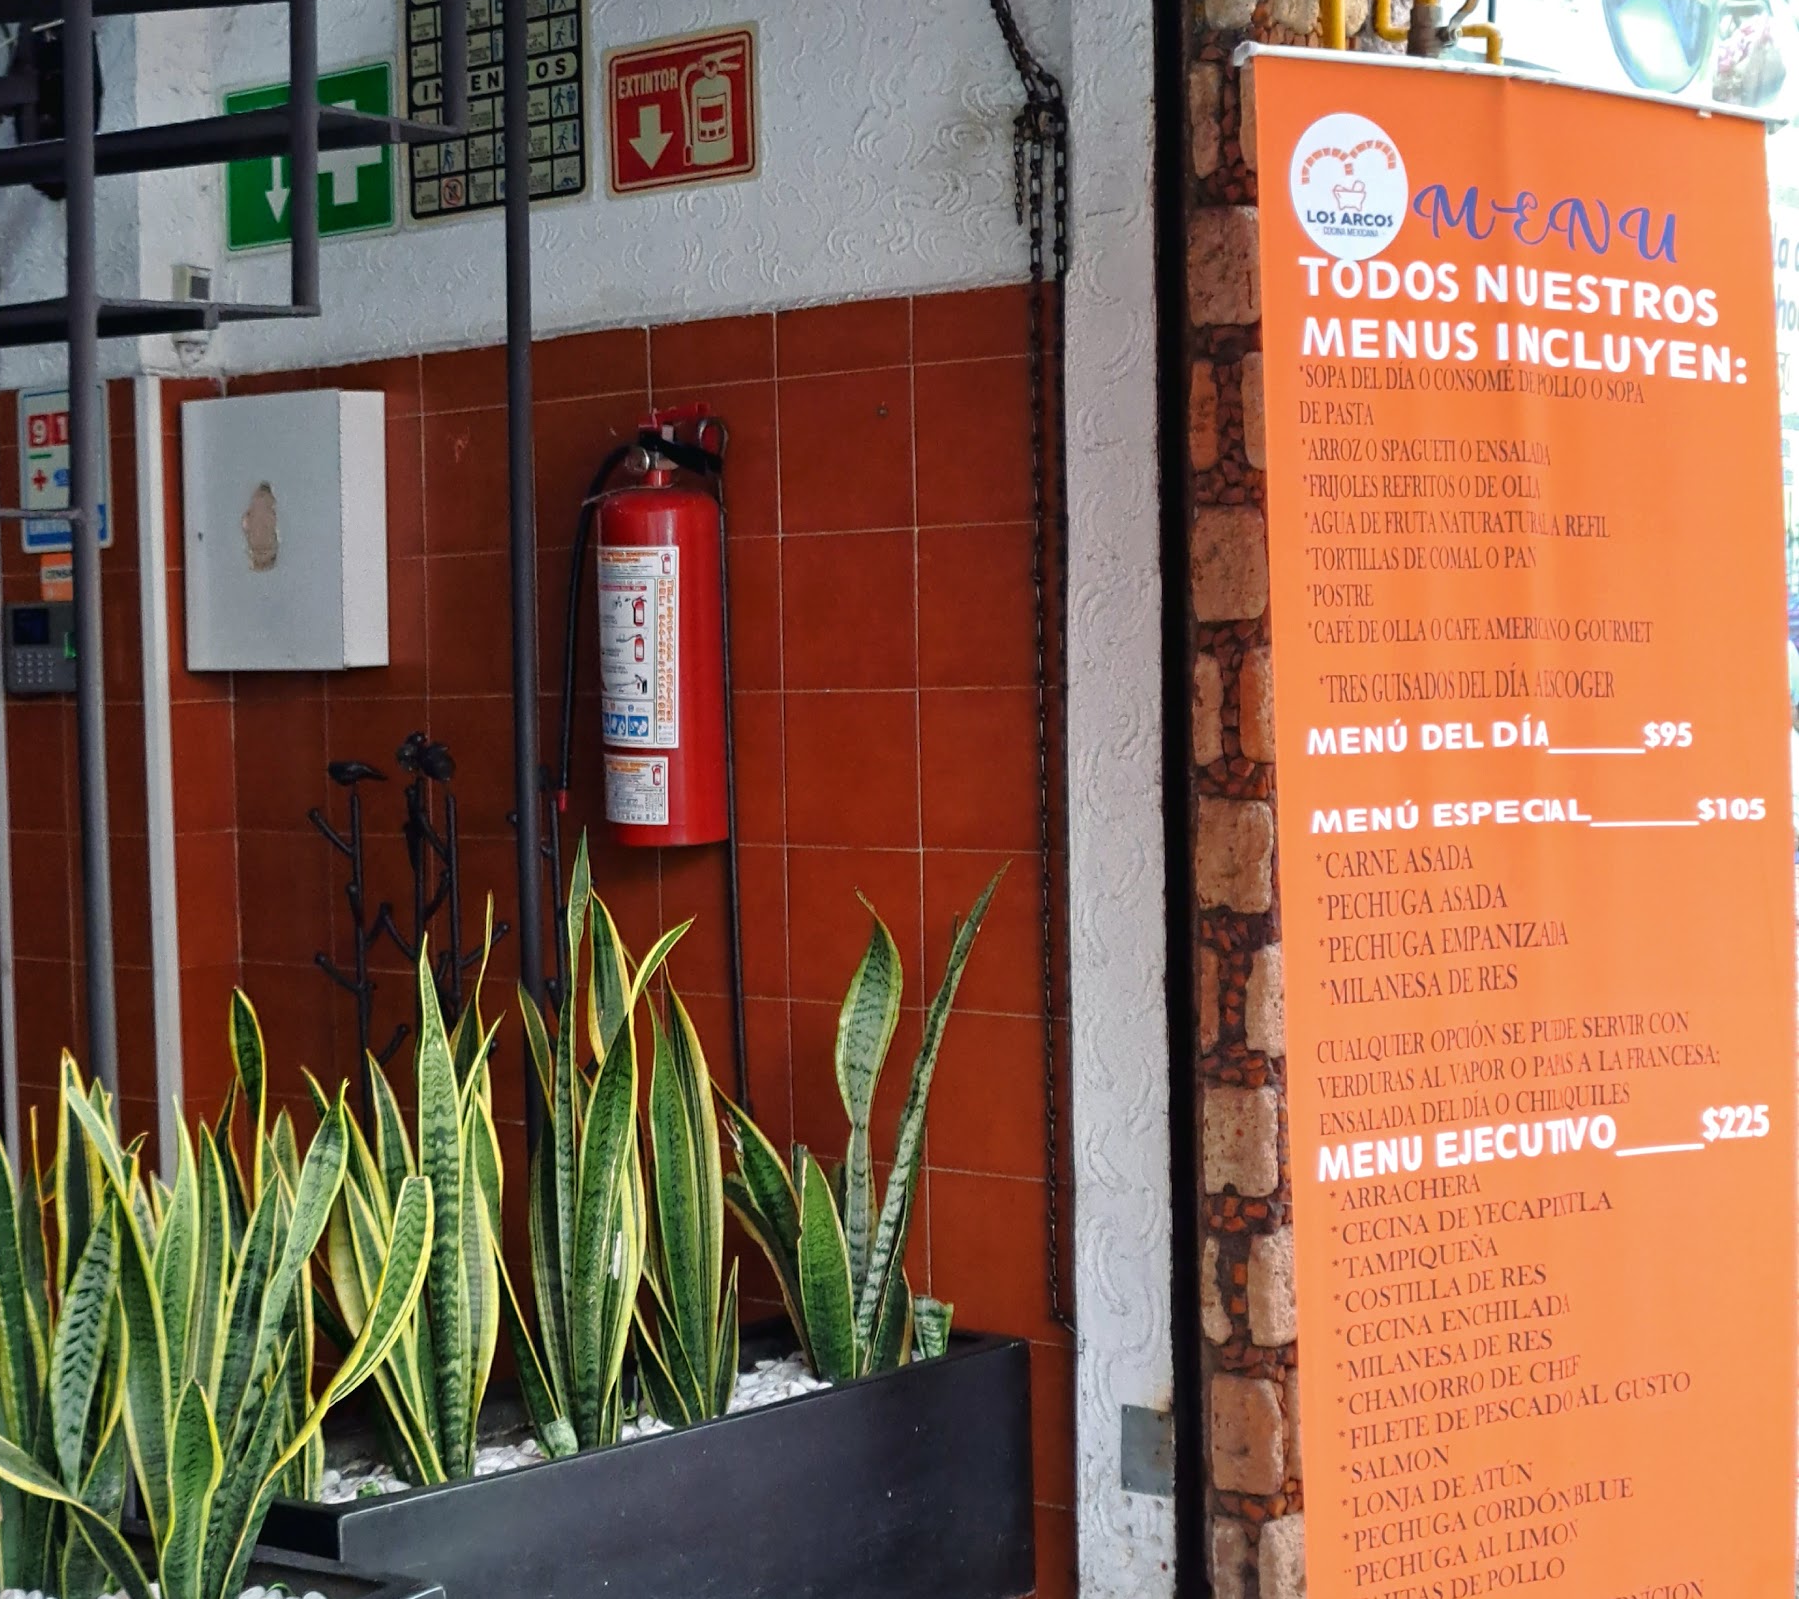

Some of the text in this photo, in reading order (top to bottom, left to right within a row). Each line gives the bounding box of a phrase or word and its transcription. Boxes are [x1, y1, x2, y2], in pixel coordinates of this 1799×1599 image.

[617, 67, 678, 100] EXTINTOR
[1307, 209, 1394, 229] LOS ARCOS
[1413, 184, 1678, 264] MENU
[1298, 255, 1459, 303] TODOS
[1476, 263, 1720, 328] NUESTROS
[1302, 317, 1747, 384] MENUS INCLUYEN:
[1306, 361, 1645, 404] SOPA DEL DÍA CONSOMÉ POLLO SOPA
[1325, 401, 1374, 426] PASTA
[1381, 439, 1456, 463] SPAGUETI
[1476, 441, 1551, 466] ENSALADA
[1383, 475, 1455, 499] REFRITOS
[1386, 511, 1436, 534] FRUTA
[1565, 514, 1611, 538] REFIL
[1430, 546, 1482, 570] COMAL
[1503, 546, 1537, 568] PAN
[1382, 619, 1426, 643] OLLA
[1444, 618, 1481, 641] CAFE
[1485, 616, 1570, 641] AMERICANO
[1575, 618, 1654, 643] GOURMET
[1372, 672, 1455, 702] GUISADOS
[1459, 670, 1492, 700] DEL
[1495, 662, 1530, 698] DÍA
[1307, 713, 1694, 755] MENÚ DEL DÍA $95
[1311, 798, 1767, 834] MENÚ ESPECIAL $105
[1404, 844, 1474, 874] ASADA
[1439, 884, 1509, 914] ASADA
[1441, 920, 1569, 954] EMPANIZADA
[1479, 963, 1519, 992] RES
[1317, 1033, 1425, 1064] CUALQUIER
[1431, 1020, 1497, 1054] OPCIÓN
[1501, 1019, 1526, 1045] SE
[1583, 1014, 1644, 1040] SERVIR
[1649, 1011, 1689, 1036] CON
[1317, 1068, 1415, 1100] VERDURAS
[1419, 1064, 1446, 1090] AL
[1450, 1057, 1505, 1086] VAPOR
[1598, 1048, 1623, 1072] LA
[1320, 1082, 1630, 1137] ENSALADA DEL DÍA CHILAQUILES
[1318, 1105, 1770, 1182] MENU EJECUTIVO $225
[1340, 1173, 1481, 1212] ARRACHERA
[1342, 1213, 1430, 1245] CECINA
[1345, 1263, 1547, 1313] COSTILLA RES
[1346, 1293, 1572, 1347] CECINA ENCHILADA
[1347, 1328, 1553, 1381] MILANESA RES
[1349, 1354, 1582, 1415] CHAMORRO CHEF
[1350, 1371, 1692, 1450] FILETE PESCADO AL GUSTO
[1353, 1459, 1534, 1519] LONJA ATÚN
[1354, 1510, 1468, 1552] PECHUGA
[1574, 1476, 1635, 1508] BLUE
[1474, 1536, 1501, 1563] AL
[1487, 1556, 1566, 1594] POLLO
